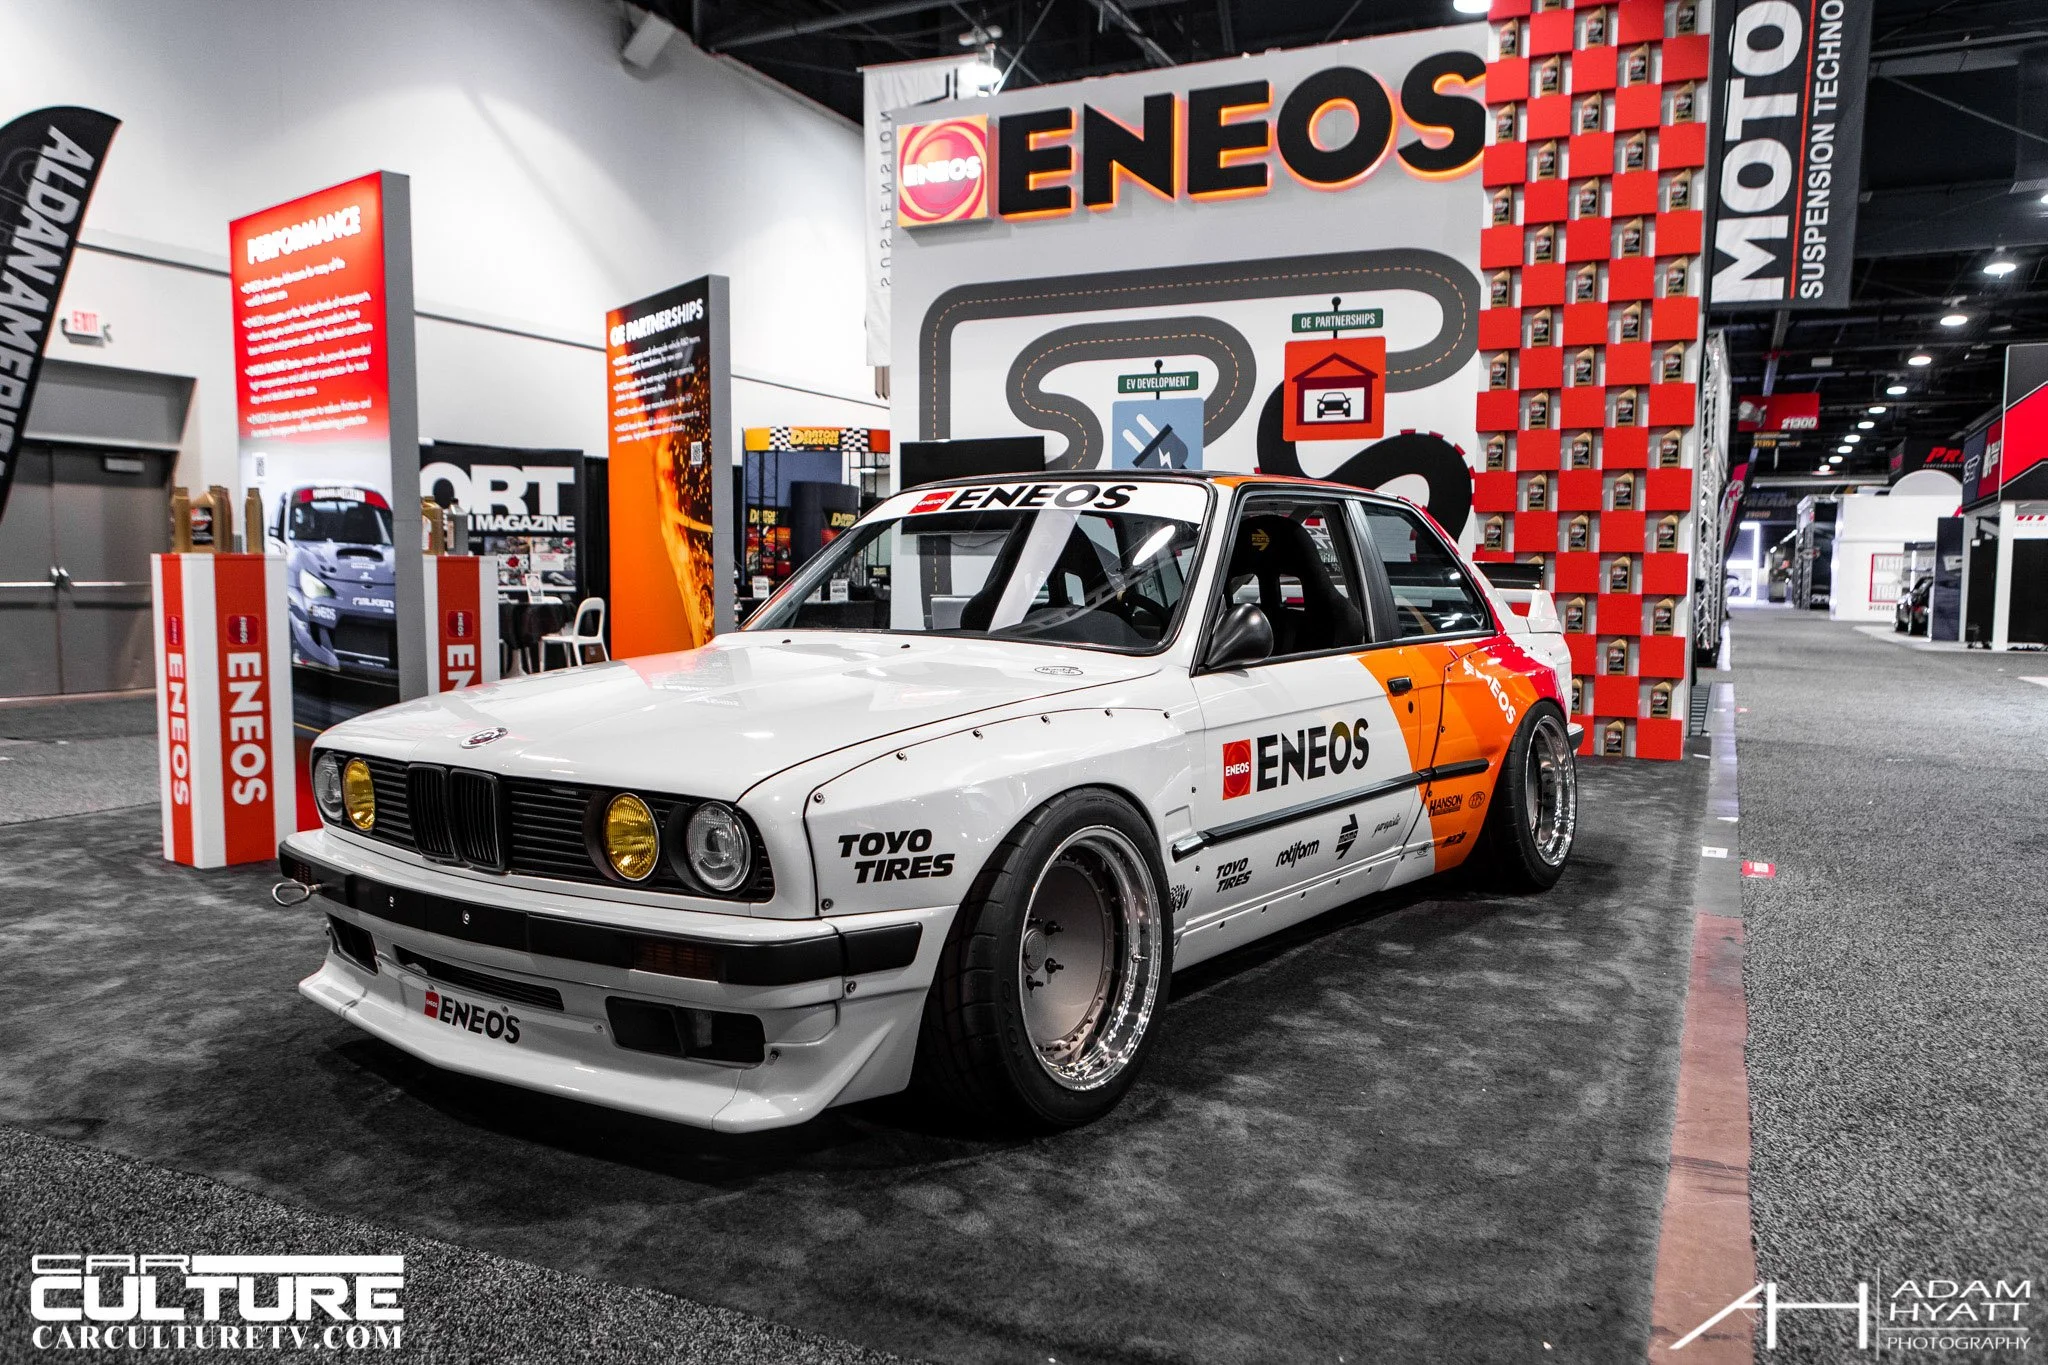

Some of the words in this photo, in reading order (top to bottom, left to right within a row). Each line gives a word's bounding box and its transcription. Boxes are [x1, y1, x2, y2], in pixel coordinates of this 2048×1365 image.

[998, 50, 1487, 218] ENEOS
[902, 156, 981, 187] ENEOS
[1800, 122, 1836, 299] SUSPENSION
[247, 205, 361, 265] PERFORMANCE
[626, 298, 704, 342] PARTNERSHIPS
[1301, 317, 1311, 329] OE
[1315, 312, 1376, 328] PARTNERSHIPS
[1126, 379, 1137, 390] EV
[1137, 375, 1190, 390] DEVELOPMENT
[946, 484, 1138, 510] ENEOS
[475, 515, 576, 532] MAGAZINE
[447, 644, 475, 690] EN
[1462, 657, 1517, 725] ENEOS
[168, 652, 190, 806] ENEOS
[226, 652, 268, 806] ENEOS
[1225, 762, 1250, 777] ENEOS
[1256, 717, 1370, 793] ENEOS
[1428, 794, 1463, 818] HANSON
[838, 828, 933, 858] TOYO
[1275, 839, 1320, 868] rotiform
[854, 853, 956, 884] TIRES
[1216, 857, 1249, 879] TOYO
[1216, 870, 1253, 893] TIRES
[439, 995, 521, 1044] ENEOS
